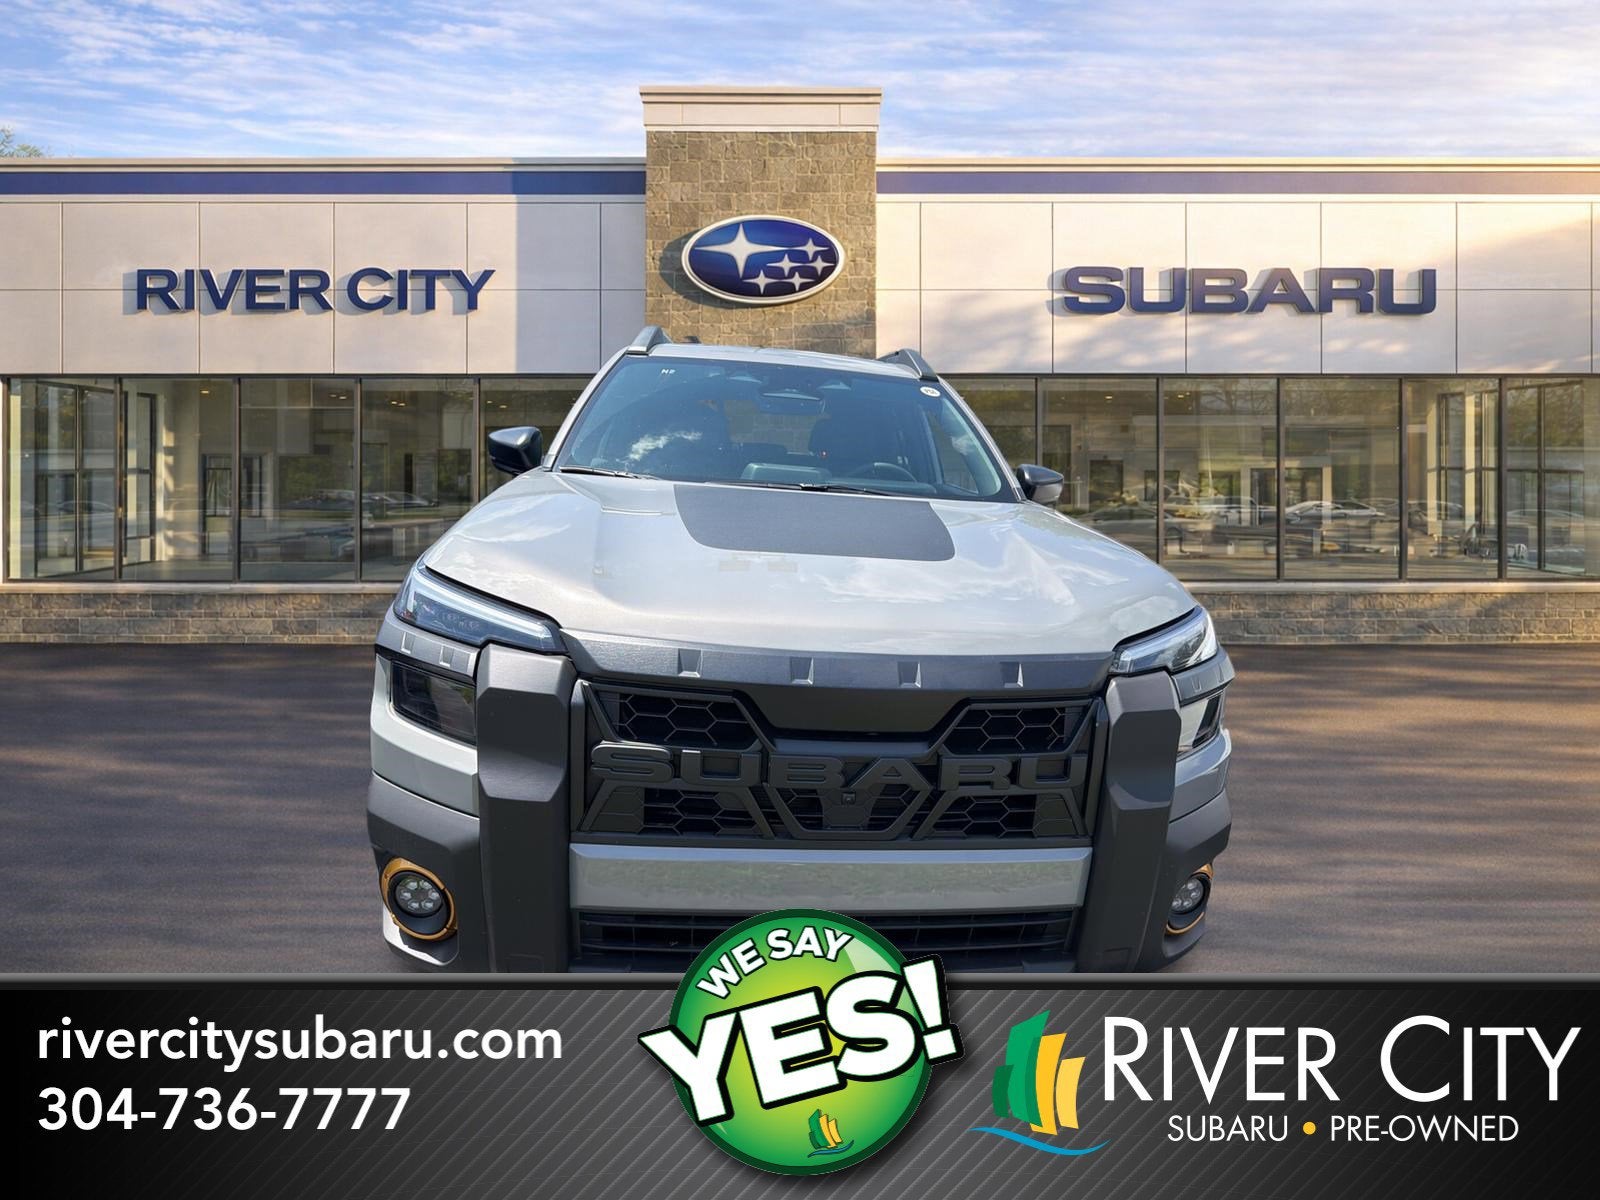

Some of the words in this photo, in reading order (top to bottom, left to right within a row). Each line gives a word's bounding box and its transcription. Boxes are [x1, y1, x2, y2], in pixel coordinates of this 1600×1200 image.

[136, 269, 333, 311] RIVER
[347, 267, 496, 311] CITY
[1063, 266, 1437, 315] SUBARU
[591, 743, 1087, 790] SUBARU
